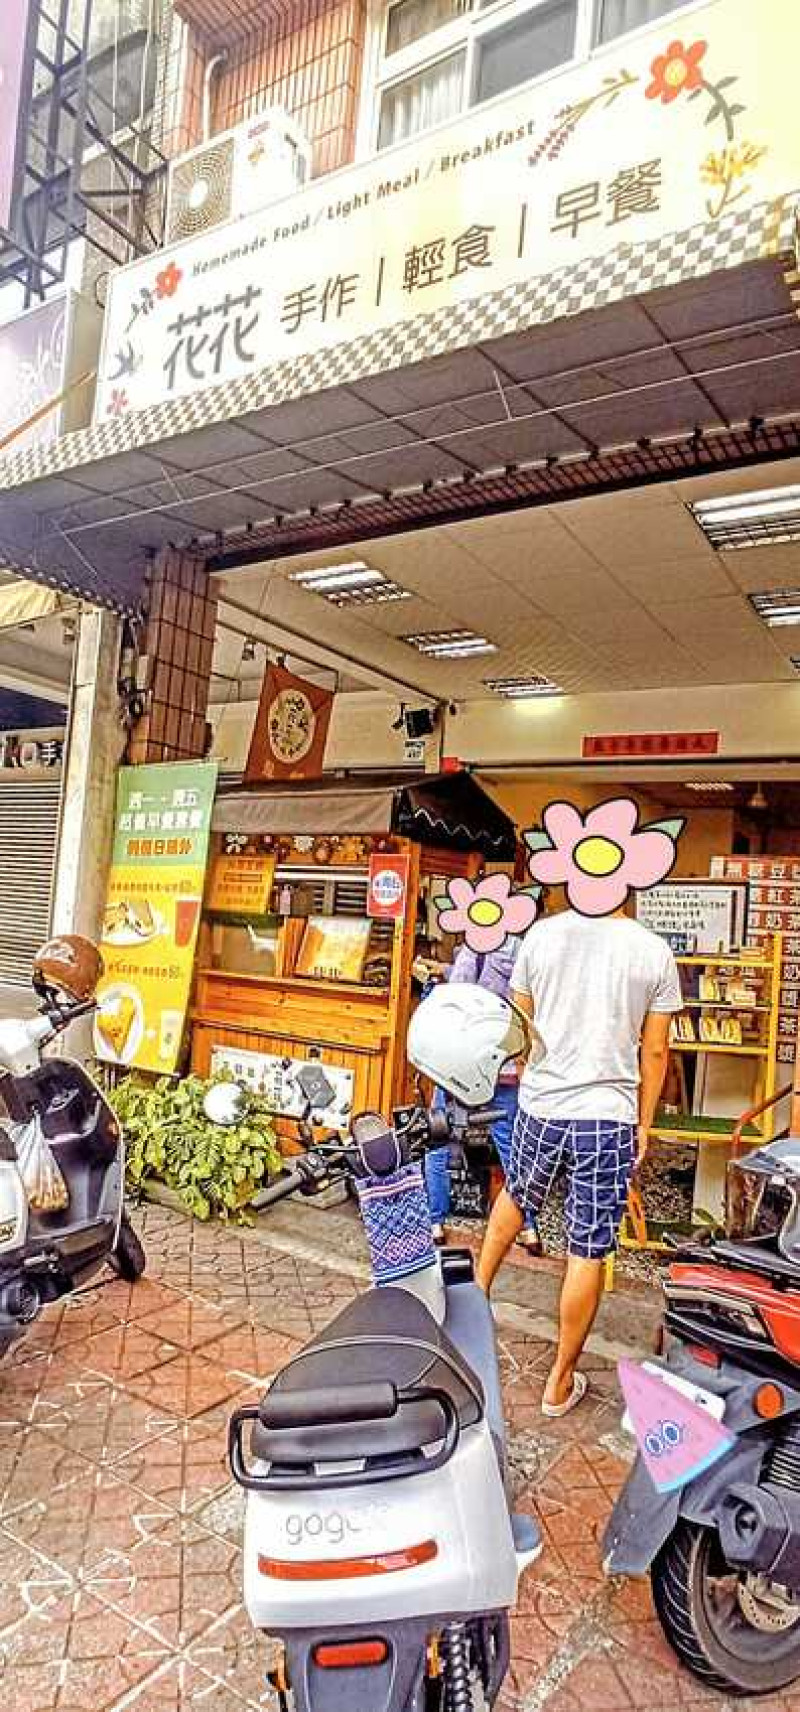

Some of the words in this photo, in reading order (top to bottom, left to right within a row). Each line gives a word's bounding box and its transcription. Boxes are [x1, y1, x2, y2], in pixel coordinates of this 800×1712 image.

[163, 284, 262, 390] 花花
[280, 274, 360, 334] 手作
[402, 224, 496, 294] 輕食
[550, 157, 662, 238] 早餐
[192, 237, 267, 277] Homemade
[274, 215, 311, 242] Food
[327, 192, 370, 220] Light
[377, 168, 420, 200] Meal
[440, 119, 536, 173] Breakfast
